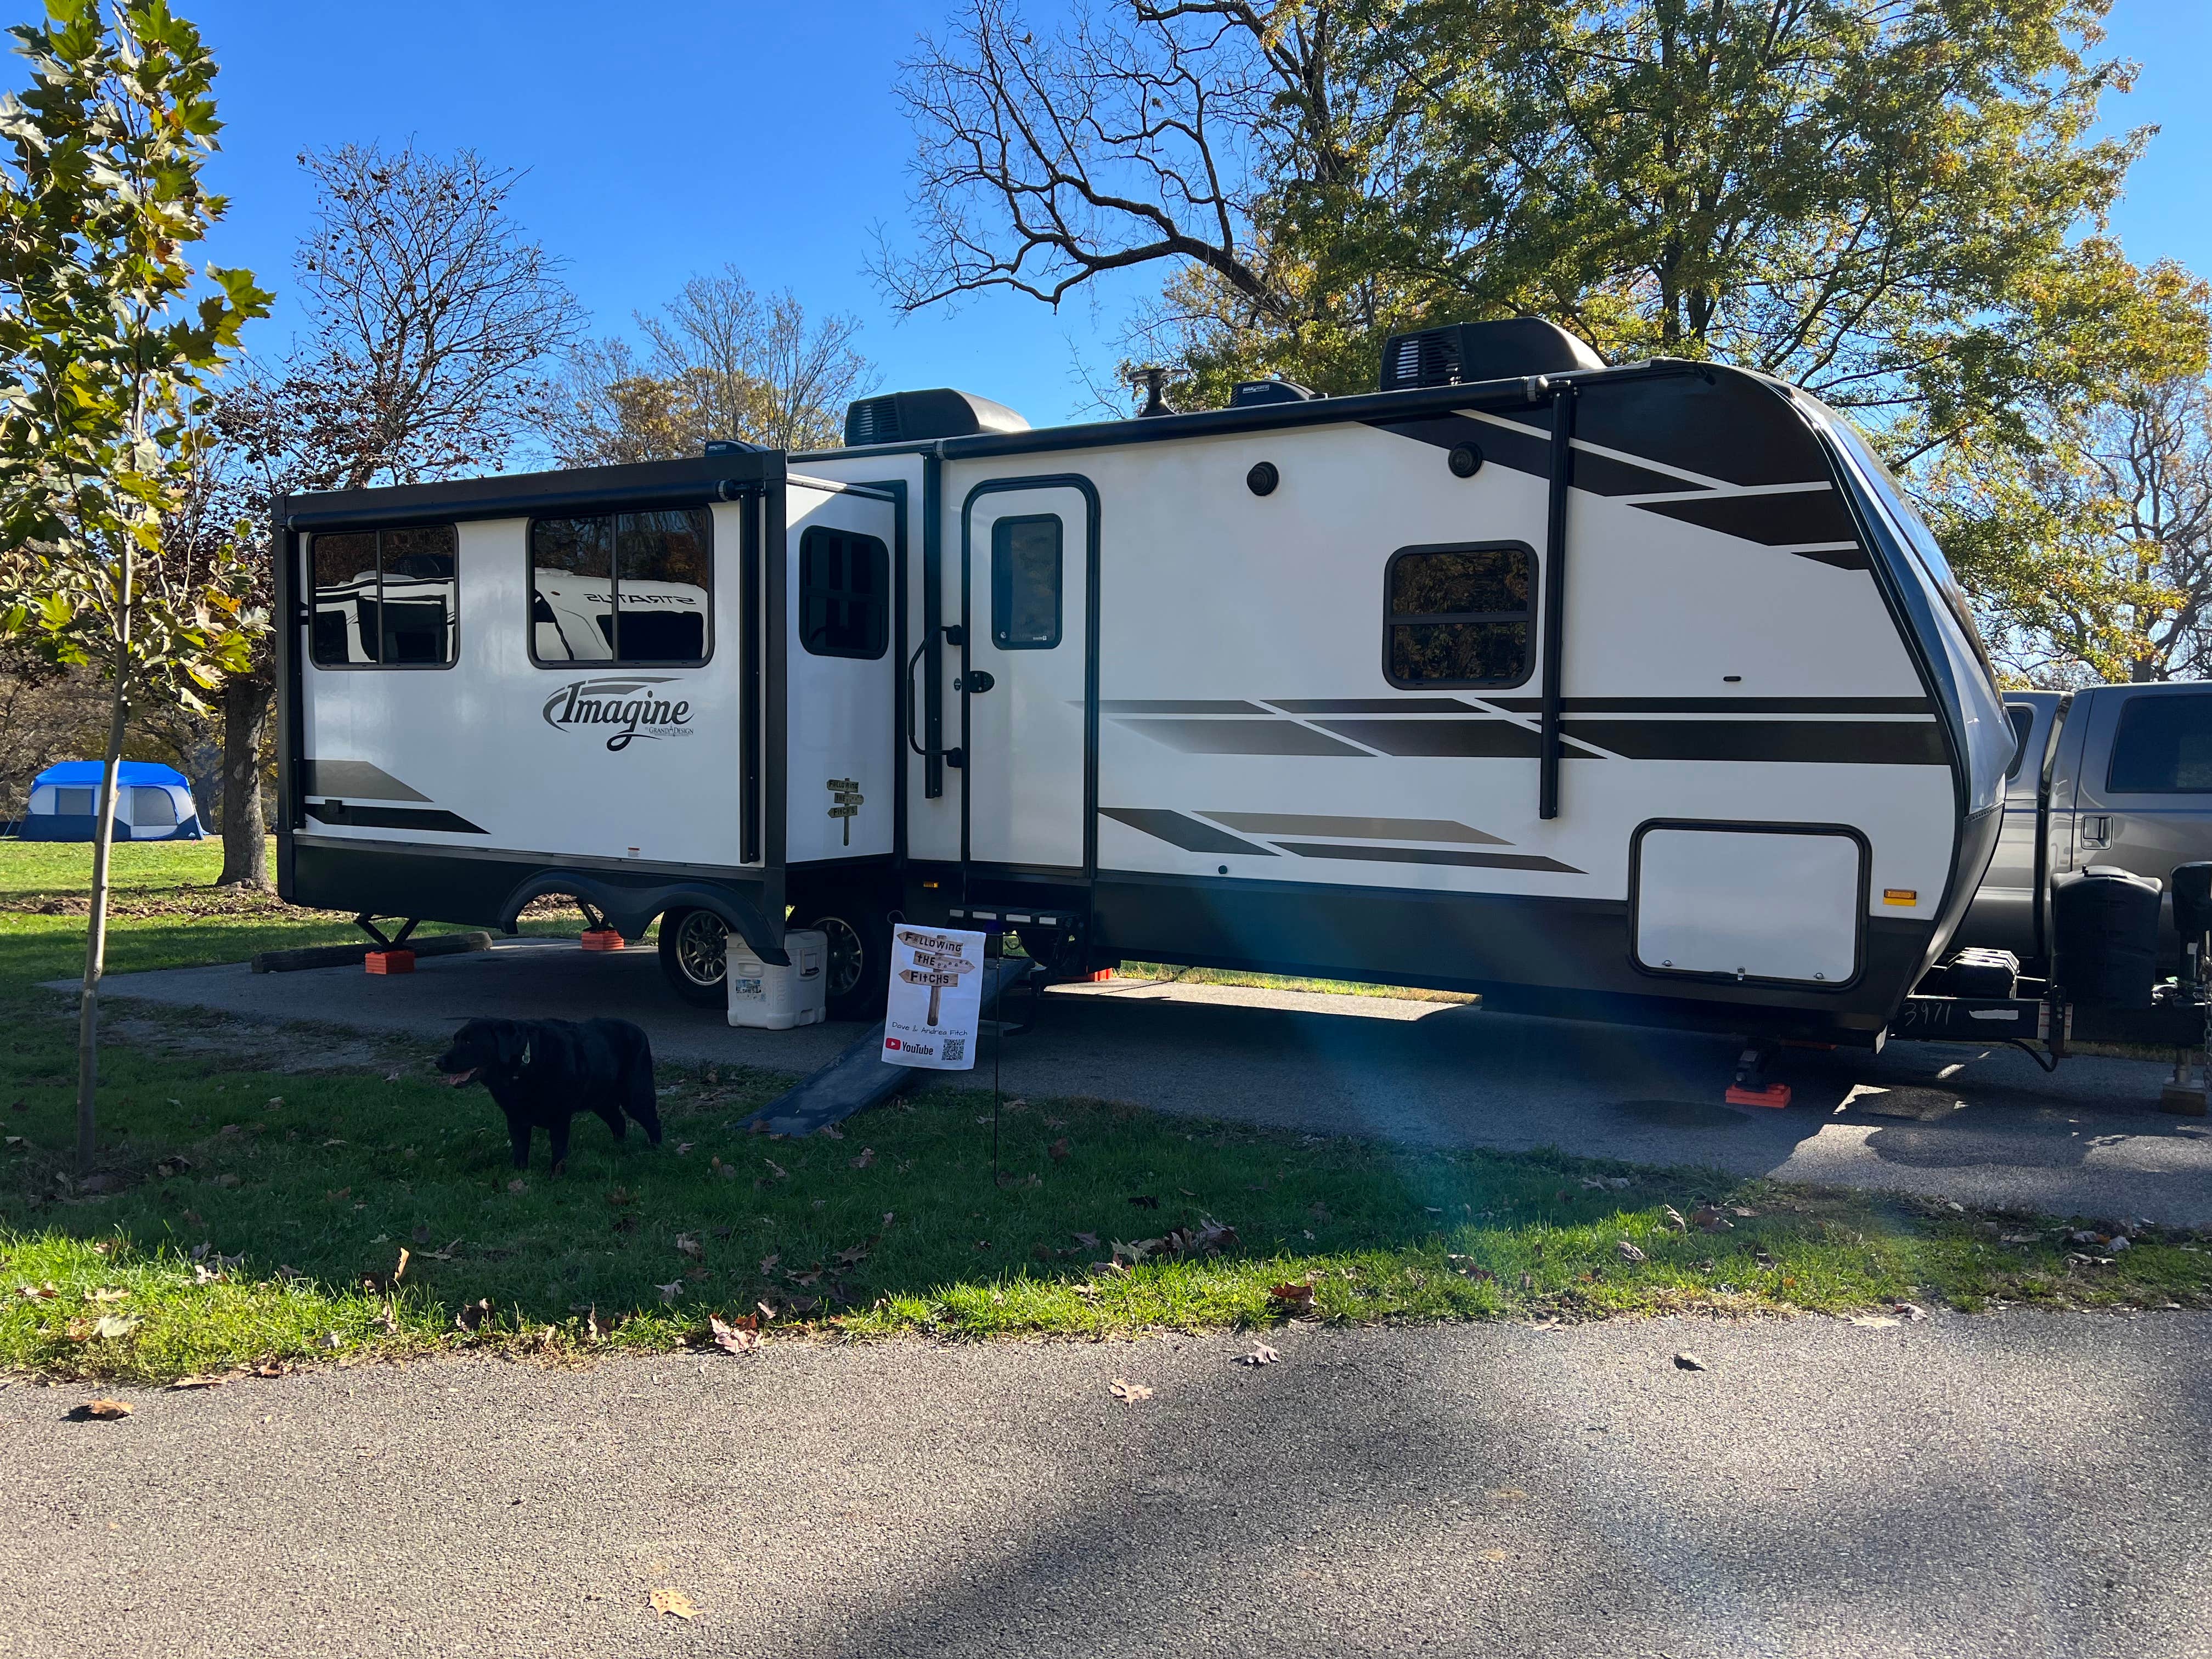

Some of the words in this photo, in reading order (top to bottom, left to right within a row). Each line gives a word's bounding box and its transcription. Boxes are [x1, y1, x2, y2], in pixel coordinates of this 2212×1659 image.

[557, 680, 695, 752] Imagine
[892, 1022, 910, 1030] Dave
[921, 1027, 947, 1035] Andrea
[902, 1041, 934, 1056] YouTube
